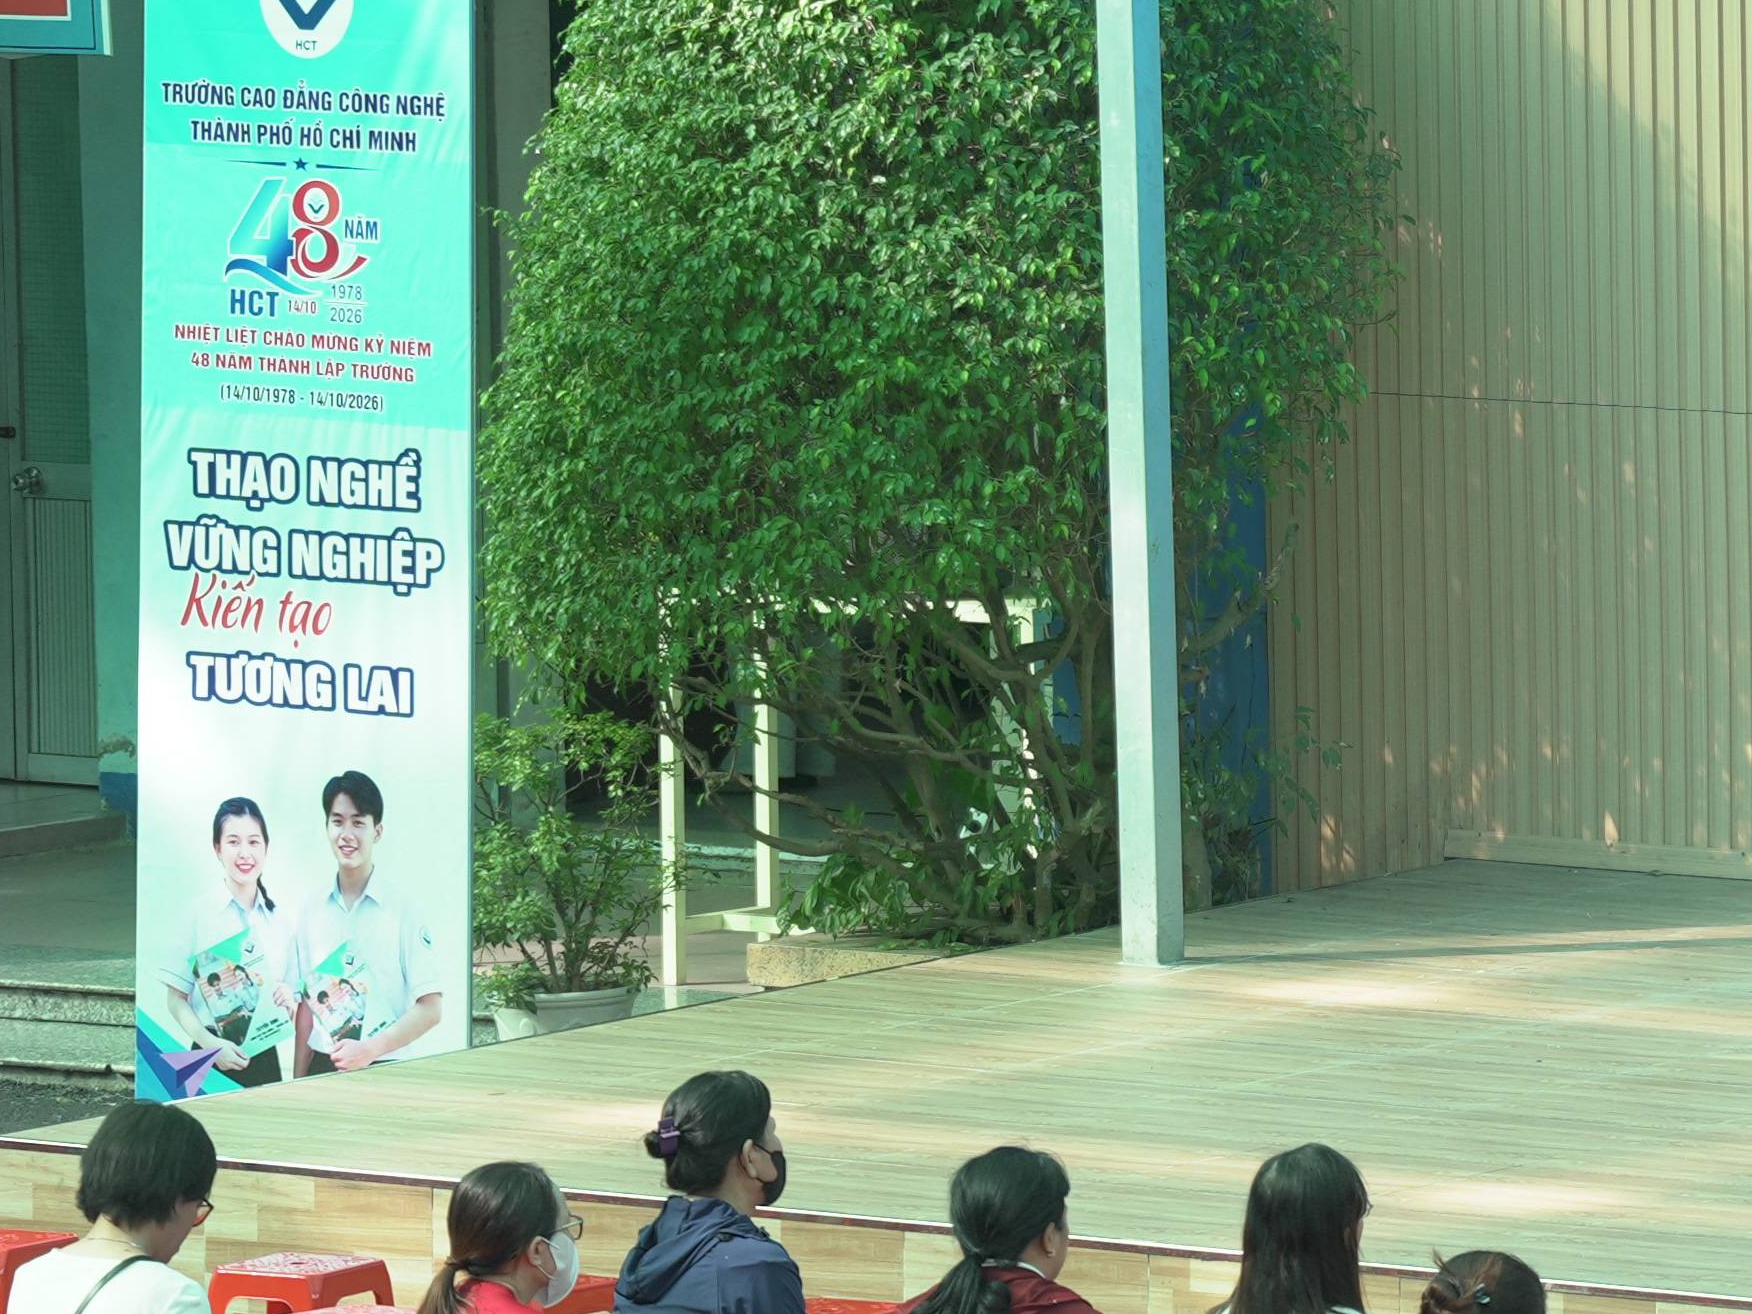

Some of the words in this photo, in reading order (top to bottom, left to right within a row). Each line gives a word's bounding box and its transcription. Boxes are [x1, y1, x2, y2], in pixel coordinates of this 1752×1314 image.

[188, 448, 299, 511] THẠO
[308, 449, 422, 513] NGHỀ
[164, 515, 280, 577] VỮNG
[288, 527, 444, 596] NGHIỆP
[180, 571, 264, 633] Kiến
[278, 591, 332, 648] tạo
[186, 651, 335, 711] TƯƠNG
[344, 663, 414, 717] LAI
